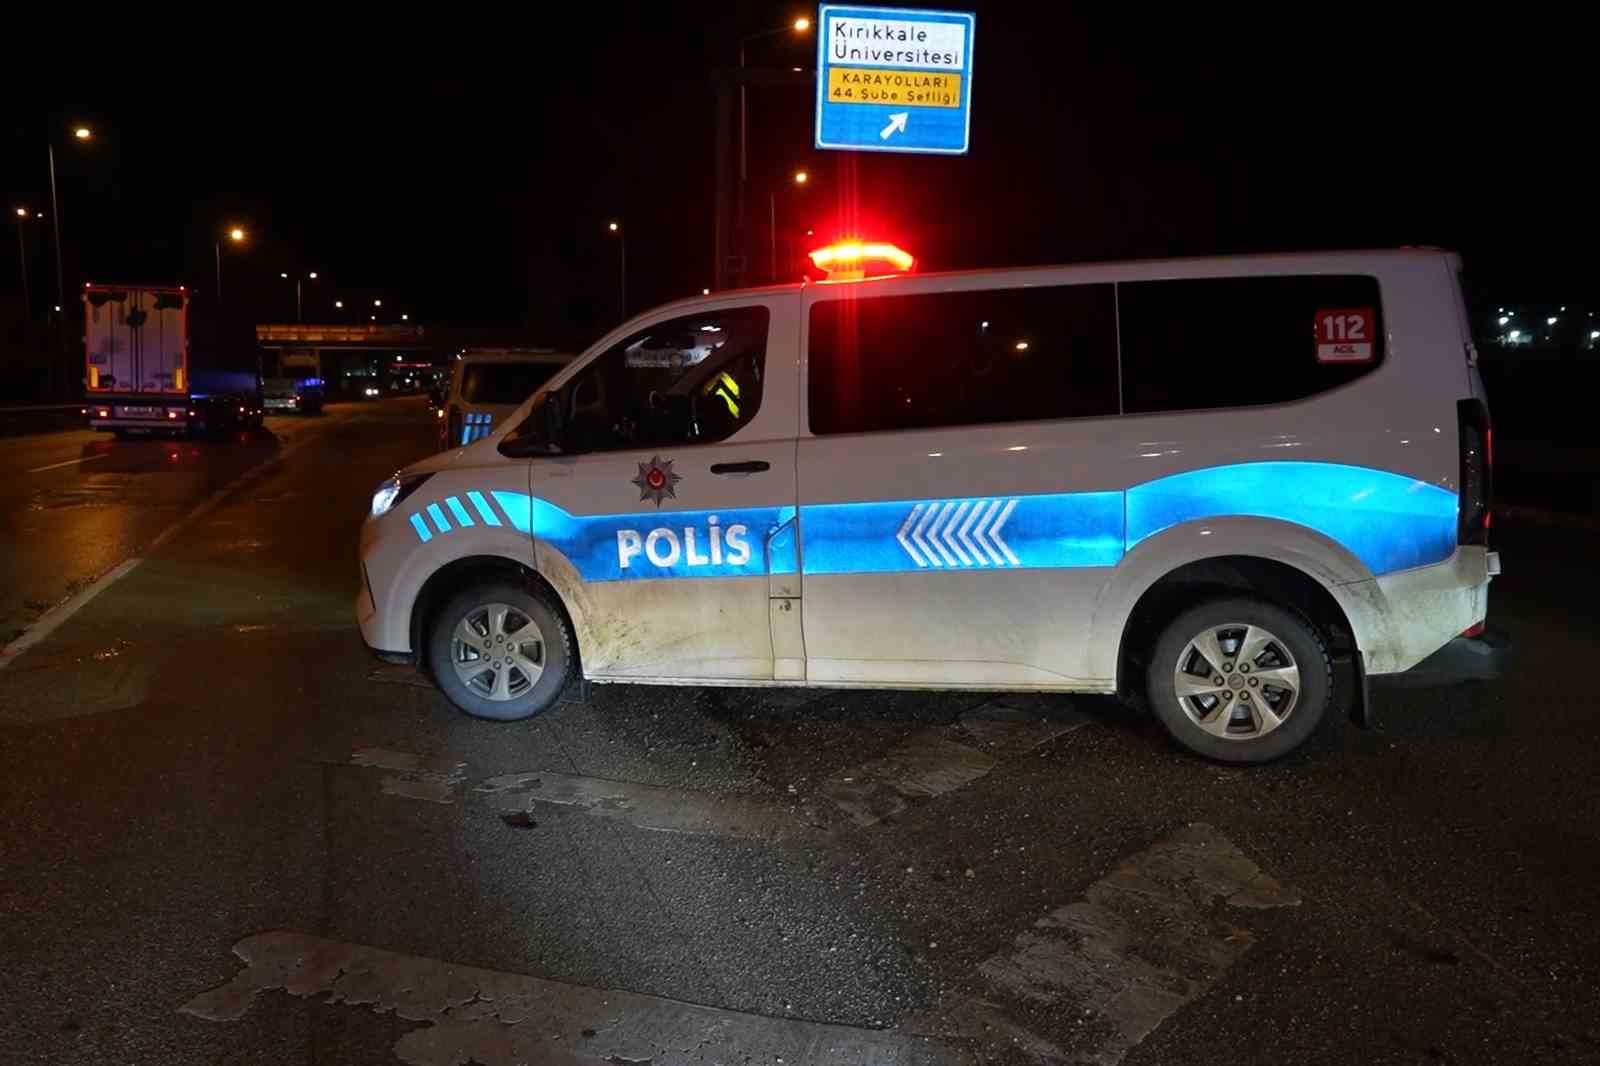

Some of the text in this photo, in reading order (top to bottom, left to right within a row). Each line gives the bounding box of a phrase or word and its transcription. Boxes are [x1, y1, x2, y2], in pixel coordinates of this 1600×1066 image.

[835, 22, 928, 42] Kırıkkale
[834, 40, 959, 65] Üniversitesi
[842, 73, 949, 88] KARAYOLLARI
[861, 89, 899, 101] Şube
[1323, 315, 1365, 339] 112
[616, 515, 752, 569] POLİS
